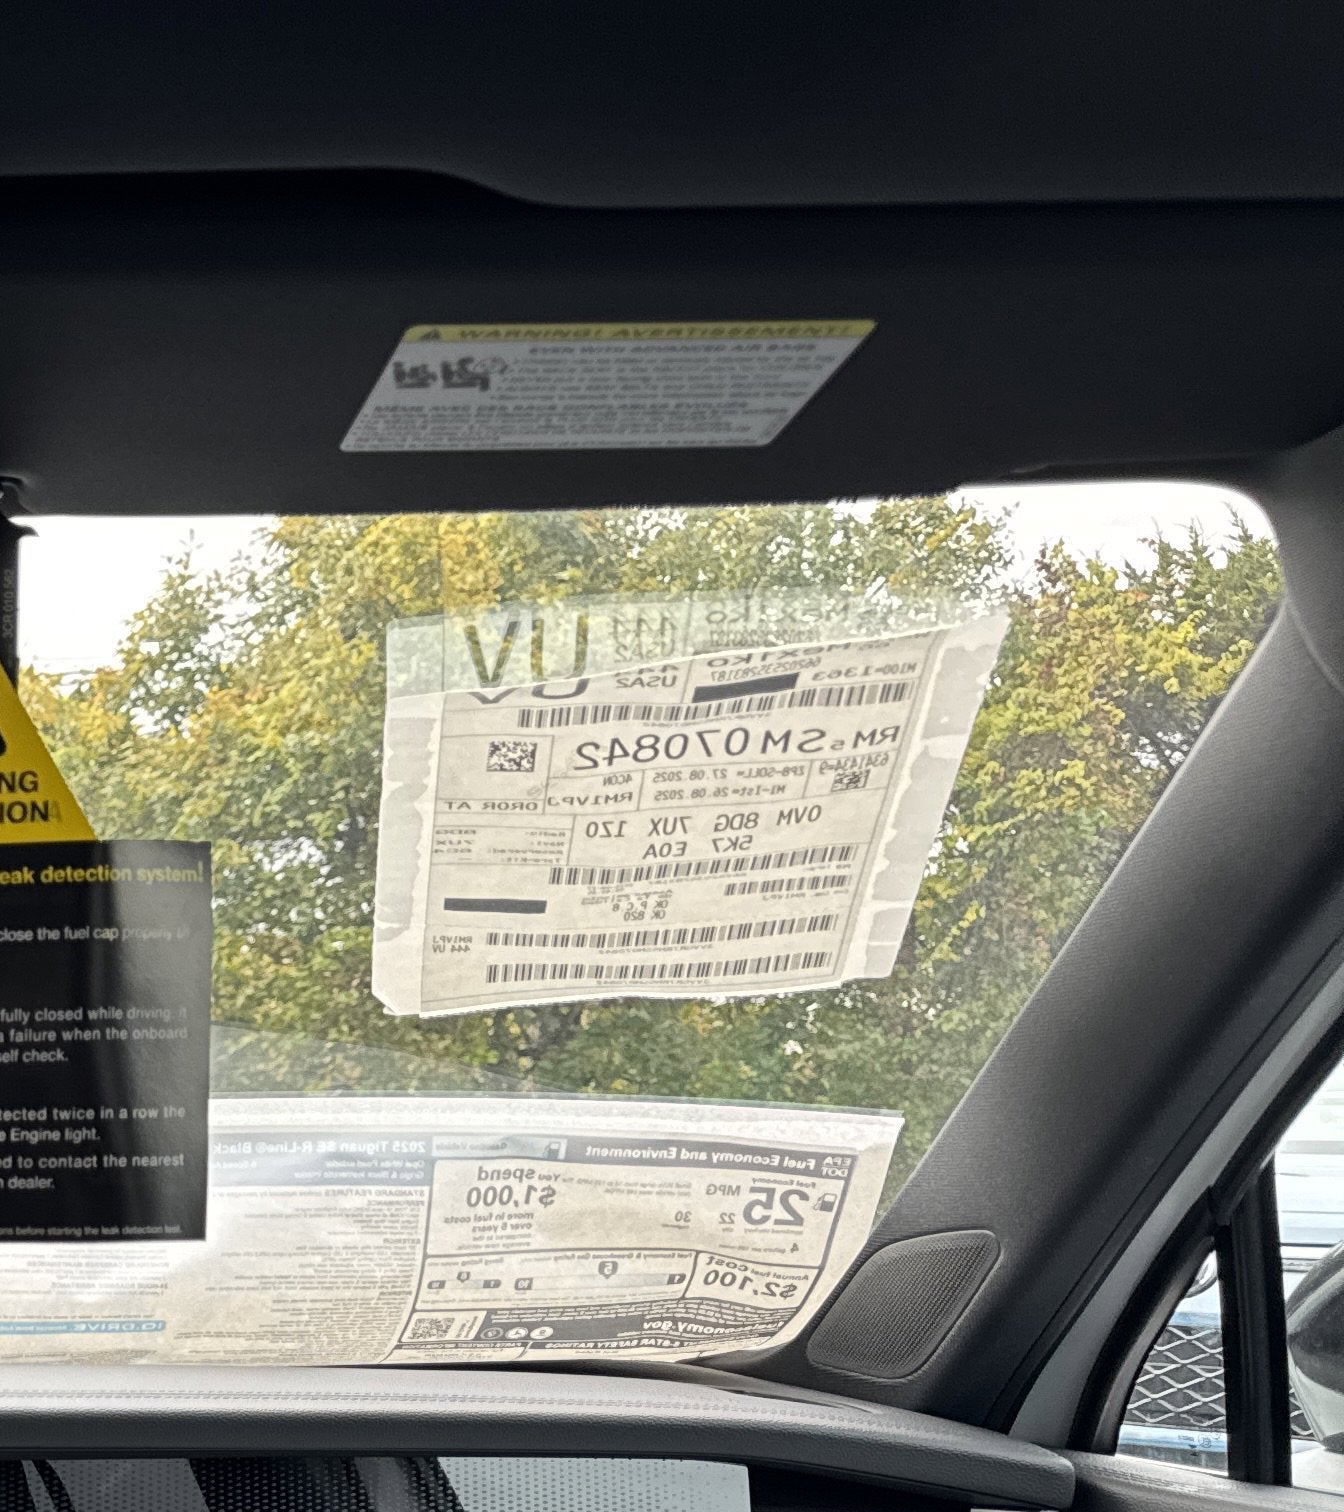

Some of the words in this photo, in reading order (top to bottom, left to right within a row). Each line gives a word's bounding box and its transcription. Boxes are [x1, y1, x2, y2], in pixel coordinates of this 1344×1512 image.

[41, 865, 133, 885] detection
[137, 861, 205, 885] system!
[37, 927, 62, 941] the
[64, 926, 90, 940] fuel
[93, 927, 120, 943] cap
[0, 1008, 30, 1026] fully
[34, 1007, 83, 1022] closed
[87, 1007, 124, 1021] while
[9, 1028, 57, 1043] failure
[61, 1027, 101, 1042] when
[105, 1027, 128, 1041] the
[131, 1025, 189, 1040] onboard
[22, 1049, 70, 1063] check.
[52, 1106, 96, 1121] twice
[132, 1107, 159, 1119] row
[162, 1105, 186, 1119] the
[10, 1127, 61, 1145] Engine
[64, 1125, 102, 1144] light.
[37, 1154, 99, 1169] contact
[102, 1153, 128, 1168] the
[131, 1153, 186, 1168] nearest
[7, 1175, 55, 1190] dealer.
